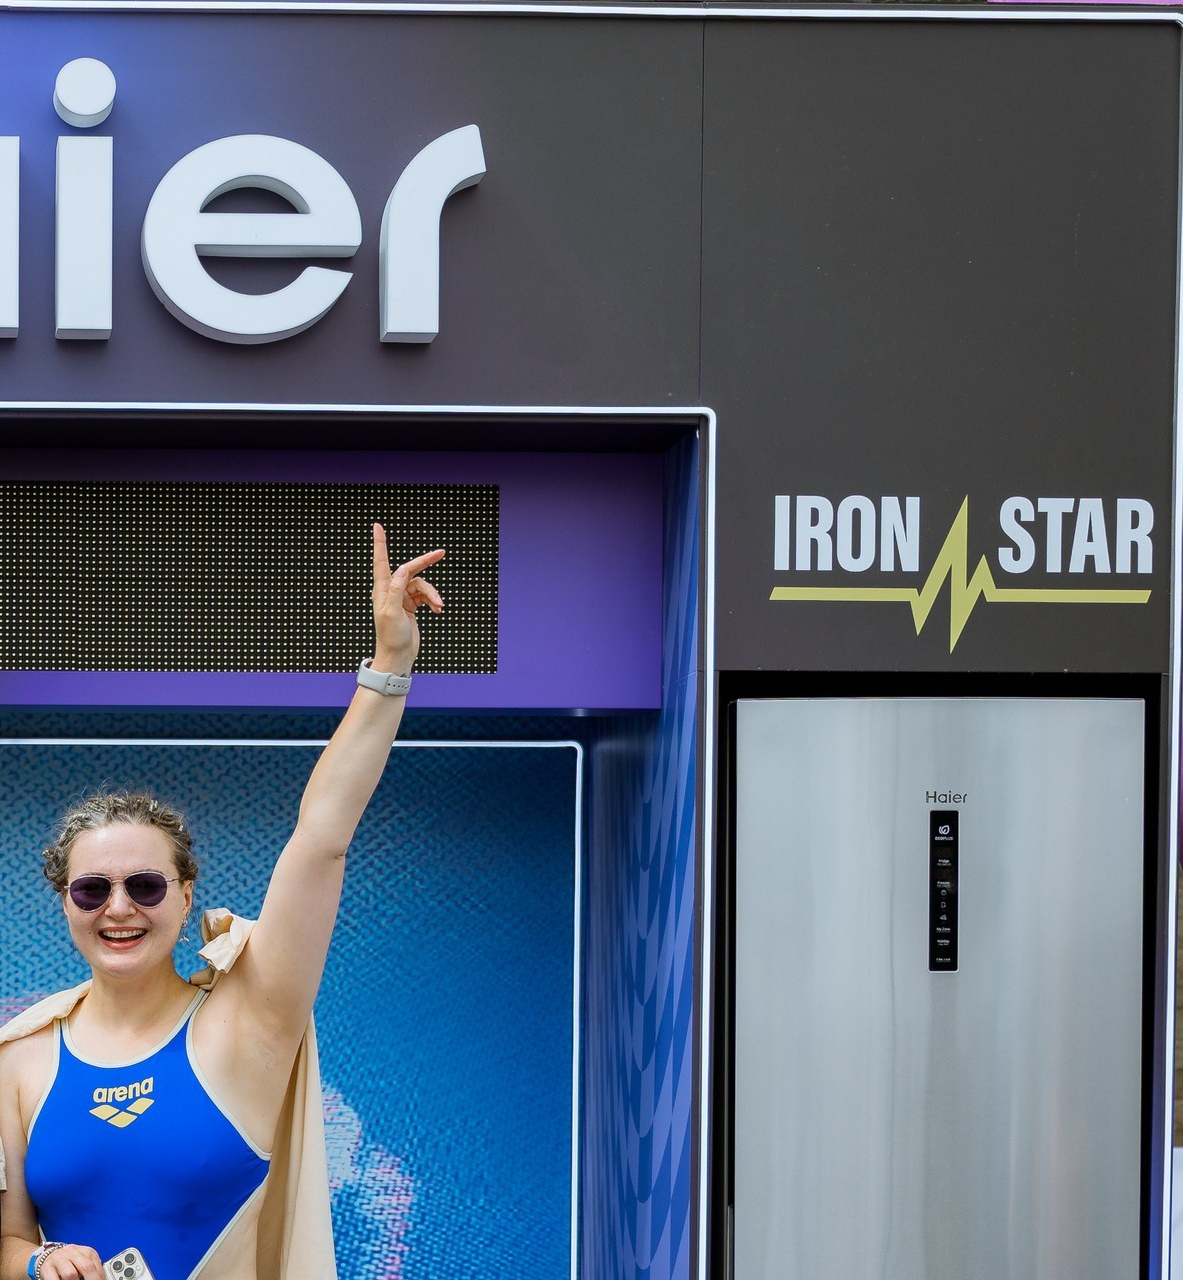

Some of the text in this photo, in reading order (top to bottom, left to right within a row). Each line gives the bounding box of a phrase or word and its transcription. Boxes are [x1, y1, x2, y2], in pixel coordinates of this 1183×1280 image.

[773, 494, 1155, 574] IRON STAR
[925, 790, 968, 804] Haier
[92, 1076, 154, 1103] arena
